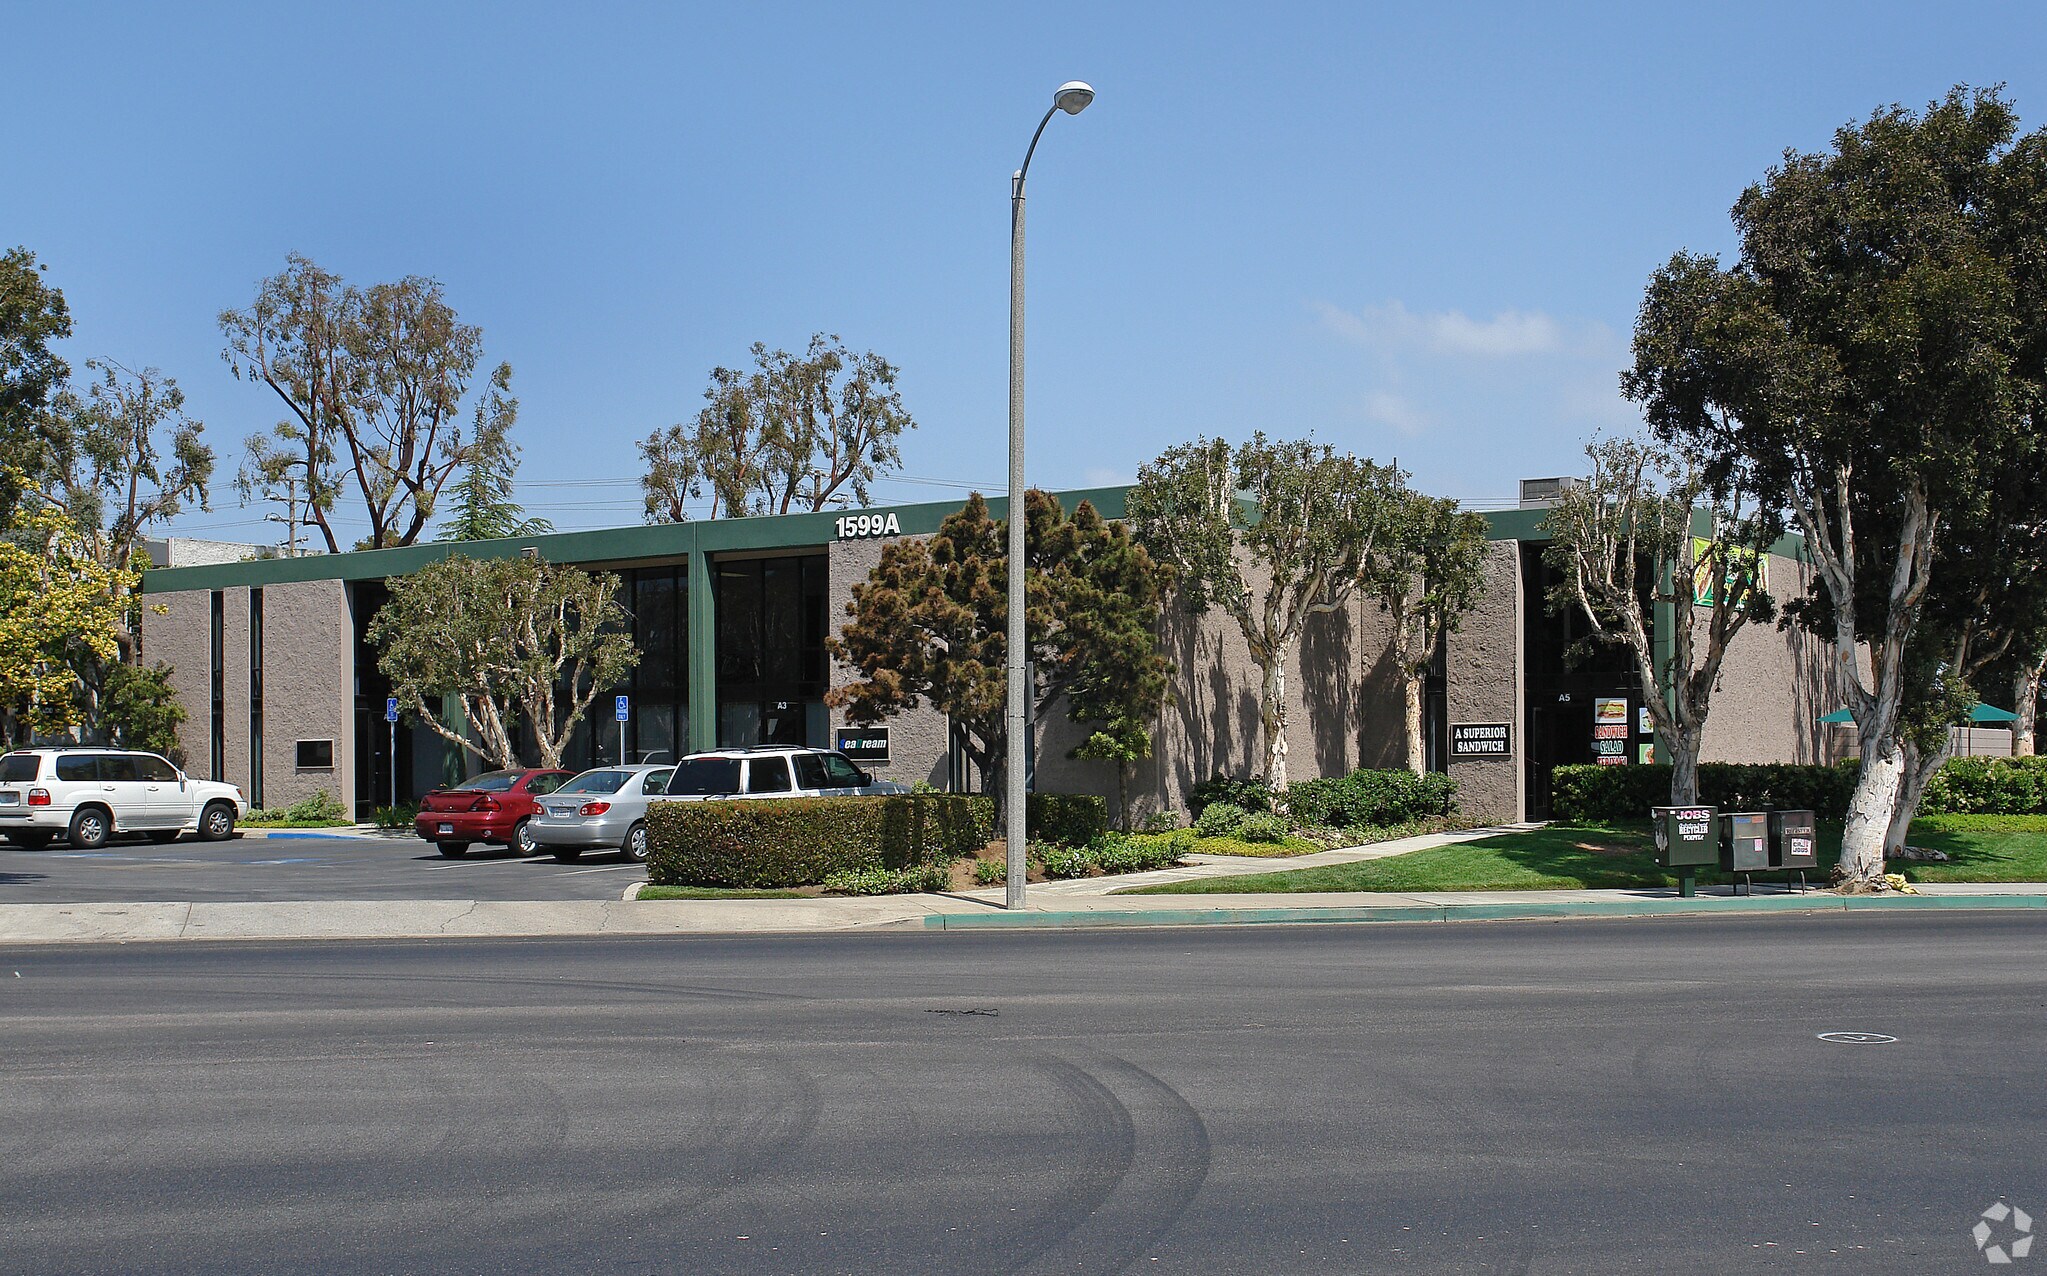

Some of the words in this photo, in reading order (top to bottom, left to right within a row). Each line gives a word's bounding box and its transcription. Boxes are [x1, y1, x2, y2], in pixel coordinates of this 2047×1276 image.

[835, 512, 901, 538] 1599A
[1558, 693, 1571, 702] A5
[777, 701, 788, 710] A3
[1455, 728, 1462, 739] A
[1463, 727, 1507, 739] SUPERIOR
[1594, 725, 1628, 739] SANDWICH
[839, 738, 887, 749] SeaDream
[1457, 741, 1504, 752] SANDWICH
[1600, 740, 1624, 755] SALAD
[1676, 809, 1711, 820] JOBS
